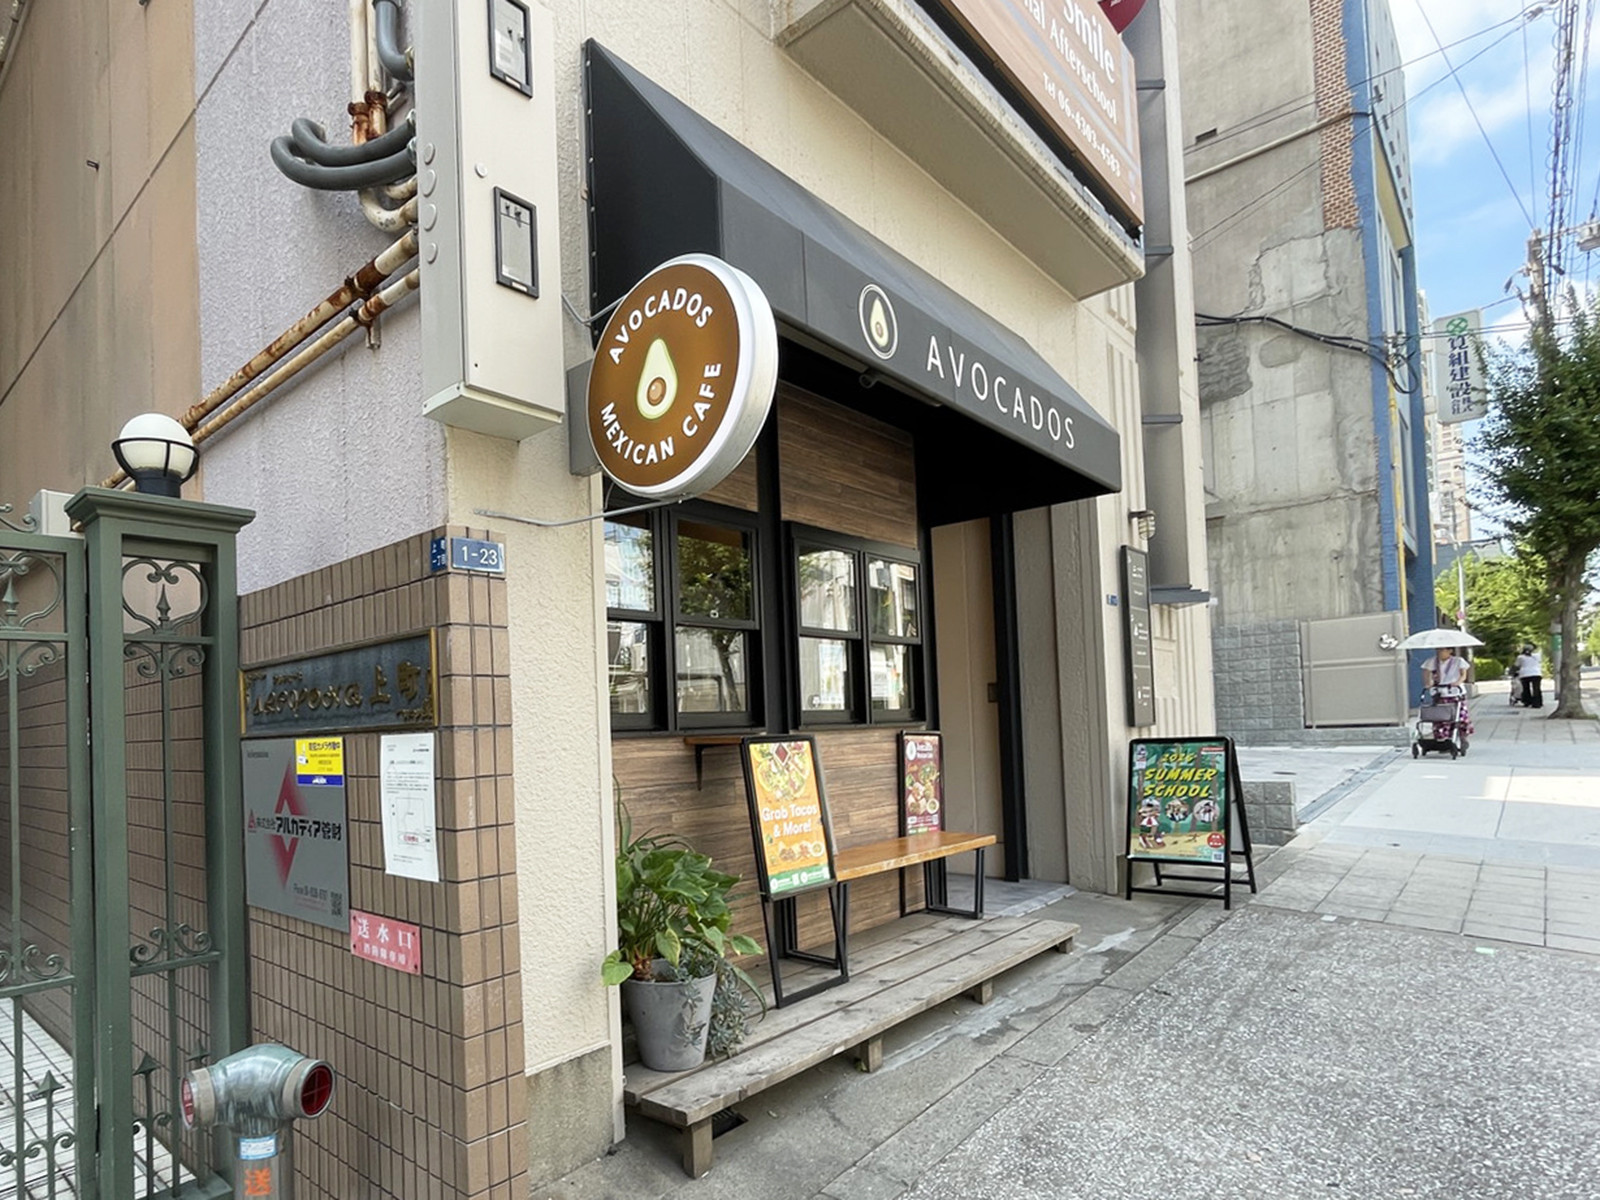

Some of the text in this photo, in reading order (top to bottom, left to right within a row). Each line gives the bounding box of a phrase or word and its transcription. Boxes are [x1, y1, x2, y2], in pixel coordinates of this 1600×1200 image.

[1043, 71, 1056, 100] Tel
[1050, 18, 1117, 124] Afterschool
[608, 287, 714, 365] AVOCADOS
[926, 335, 1076, 450] AVOCADOS
[600, 362, 722, 466] MEXICAN CAFE
[461, 545, 498, 566] 1-23
[1144, 767, 1218, 782] SUMMER
[1143, 784, 1211, 798] SCHOOL
[761, 803, 818, 822] Grab Tacos
[773, 818, 812, 838] & More!
[357, 917, 412, 950] 送水口
[244, 1167, 272, 1196] 送
